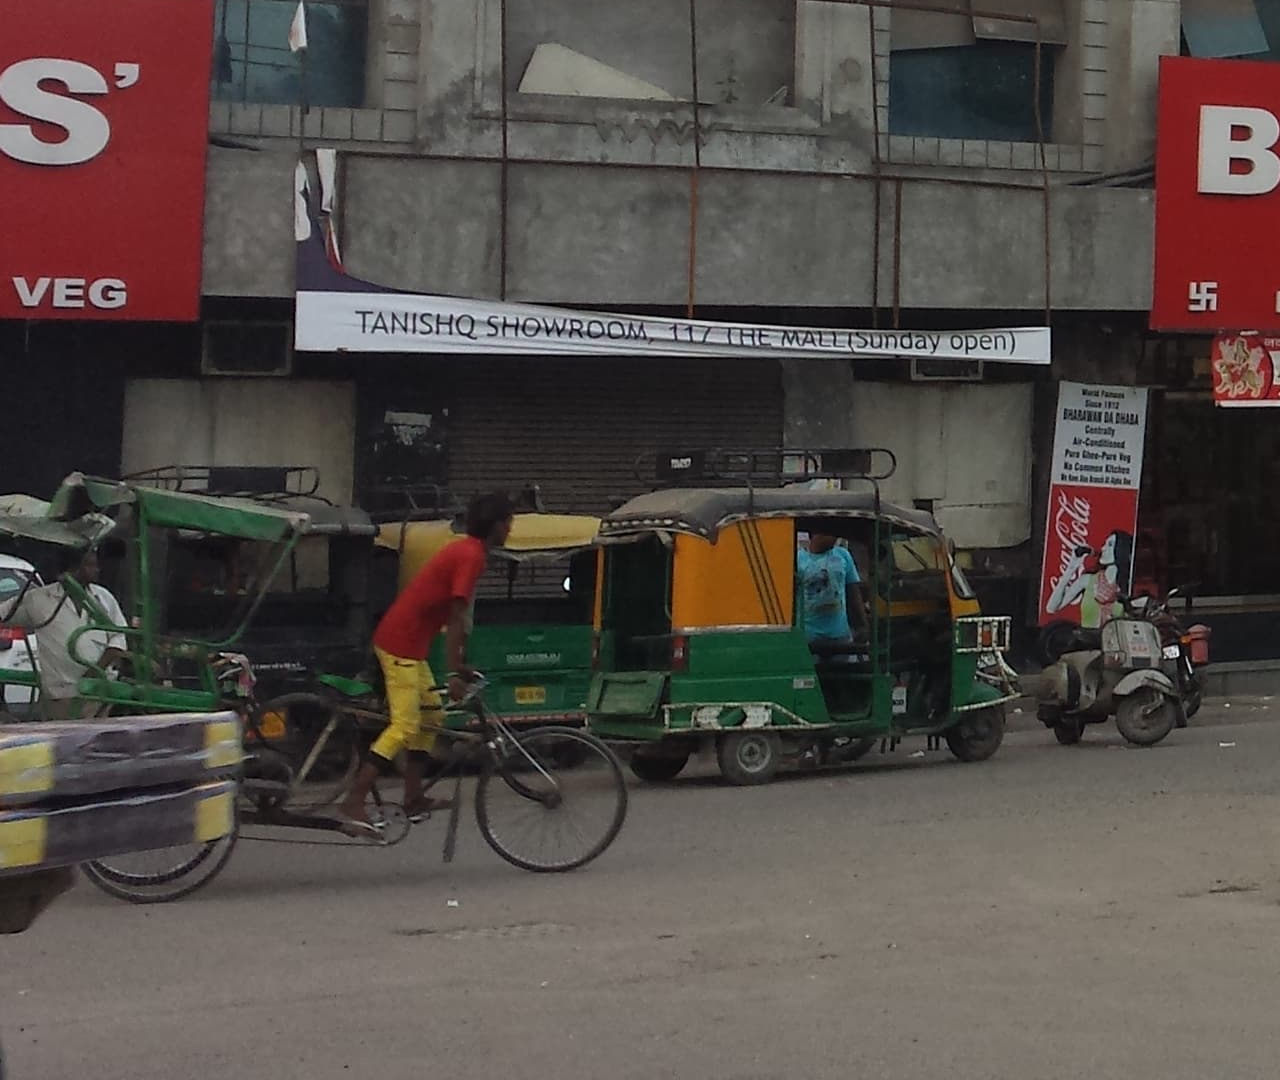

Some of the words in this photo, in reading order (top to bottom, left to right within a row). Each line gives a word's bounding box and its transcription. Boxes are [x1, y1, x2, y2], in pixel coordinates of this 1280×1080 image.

[12, 276, 129, 310] VEG
[355, 310, 478, 340] TANISHQ
[486, 314, 654, 345] SHOWROOM,
